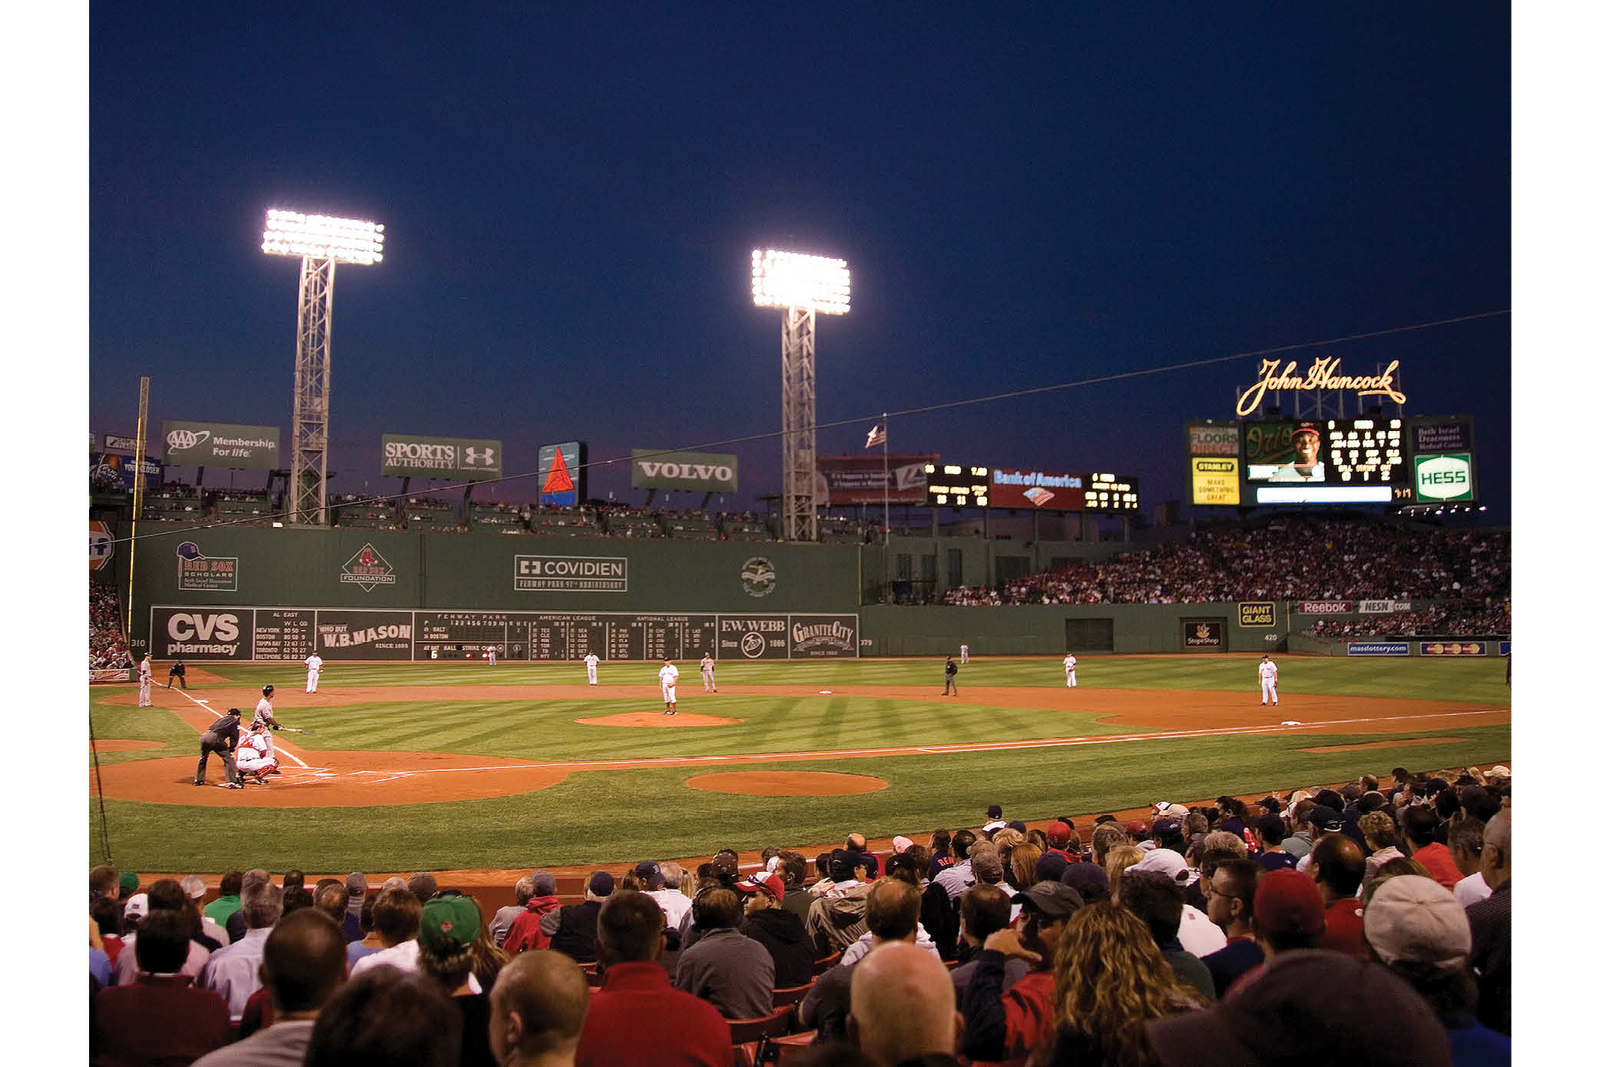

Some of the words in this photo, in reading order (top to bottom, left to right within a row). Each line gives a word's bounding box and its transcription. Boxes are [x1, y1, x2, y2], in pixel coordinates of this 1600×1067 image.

[1236, 358, 1303, 416] John
[1301, 356, 1407, 405] Hancock
[1418, 427, 1436, 435] Beth
[1438, 426, 1460, 434] Israel
[1190, 433, 1237, 444] FLOORS
[213, 448, 230, 456] For
[385, 442, 454, 460] SPORTS
[385, 458, 454, 469] AUTHORITY
[1198, 463, 1233, 472] STANLEY
[638, 461, 733, 481] VOLVO
[993, 469, 1023, 486] Bank
[1024, 472, 1036, 486] of
[1036, 472, 1082, 488] America
[1421, 471, 1466, 486] HESS
[184, 561, 208, 571] RED
[211, 562, 234, 572] SOX
[544, 561, 622, 576] COVIDIEN
[1242, 606, 1272, 615] GIANT
[1304, 602, 1347, 613] Reebok
[1364, 602, 1389, 612] NESN
[1242, 614, 1272, 623] GLASS
[168, 613, 239, 641] CVS
[748, 620, 786, 632] WEBB
[131, 639, 146, 647] 310
[721, 640, 738, 648] Since
[1350, 644, 1407, 653] masslottery.com
[168, 642, 238, 656] pharmacy
